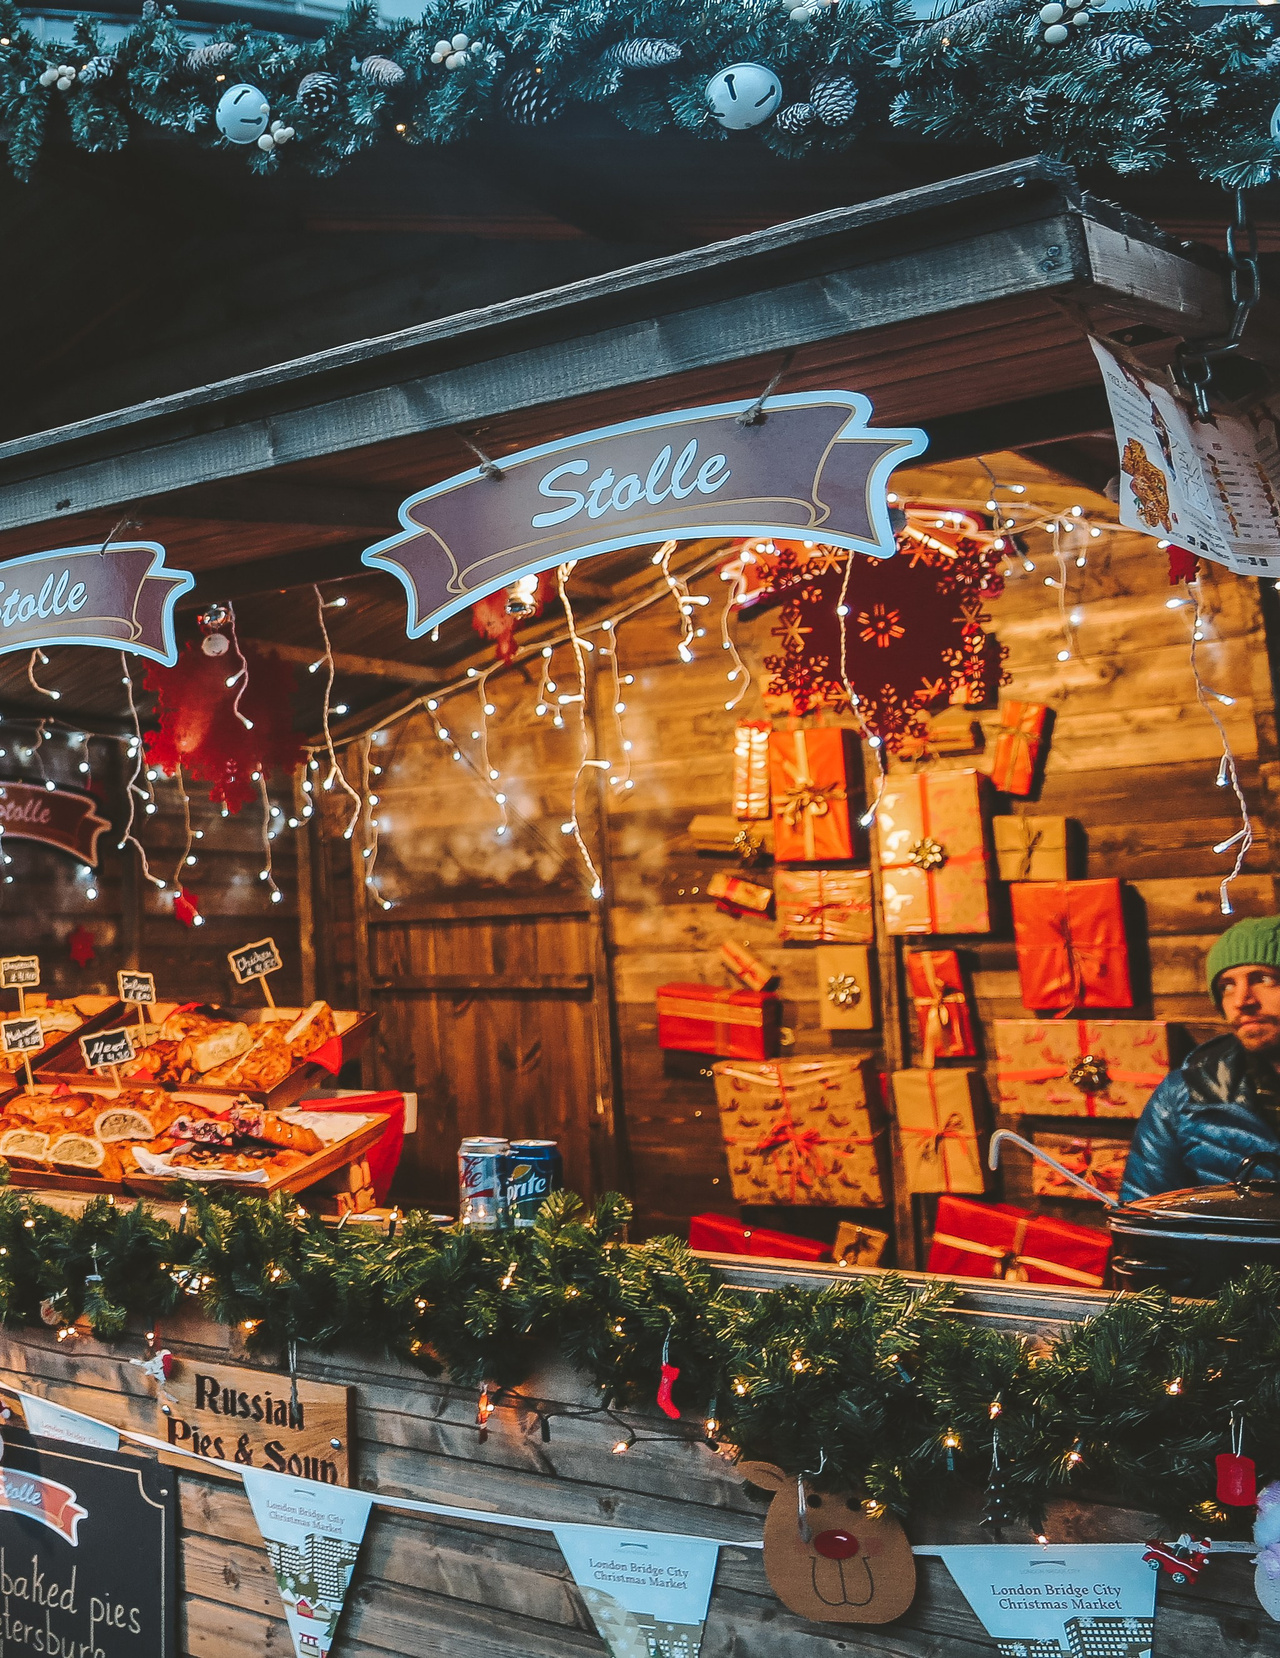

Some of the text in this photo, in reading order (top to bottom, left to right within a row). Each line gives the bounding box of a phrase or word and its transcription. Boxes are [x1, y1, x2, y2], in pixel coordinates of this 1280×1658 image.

[531, 437, 732, 529] Stolle
[89, 1039, 127, 1059] Meat
[504, 1172, 547, 1206] prite
[195, 1373, 304, 1430] Russian
[167, 1416, 225, 1460] Pies
[234, 1433, 253, 1465] &
[266, 1500, 346, 1525] London Bridge City
[269, 1511, 343, 1535] Christmas Market
[589, 1558, 690, 1579] London Bridge City
[593, 1570, 688, 1590] Christmas Market
[0, 1547, 78, 1614] baked
[89, 1592, 142, 1654] pies
[990, 1584, 1122, 1598] London Bridge City
[998, 1598, 1122, 1610] Christmas Market
